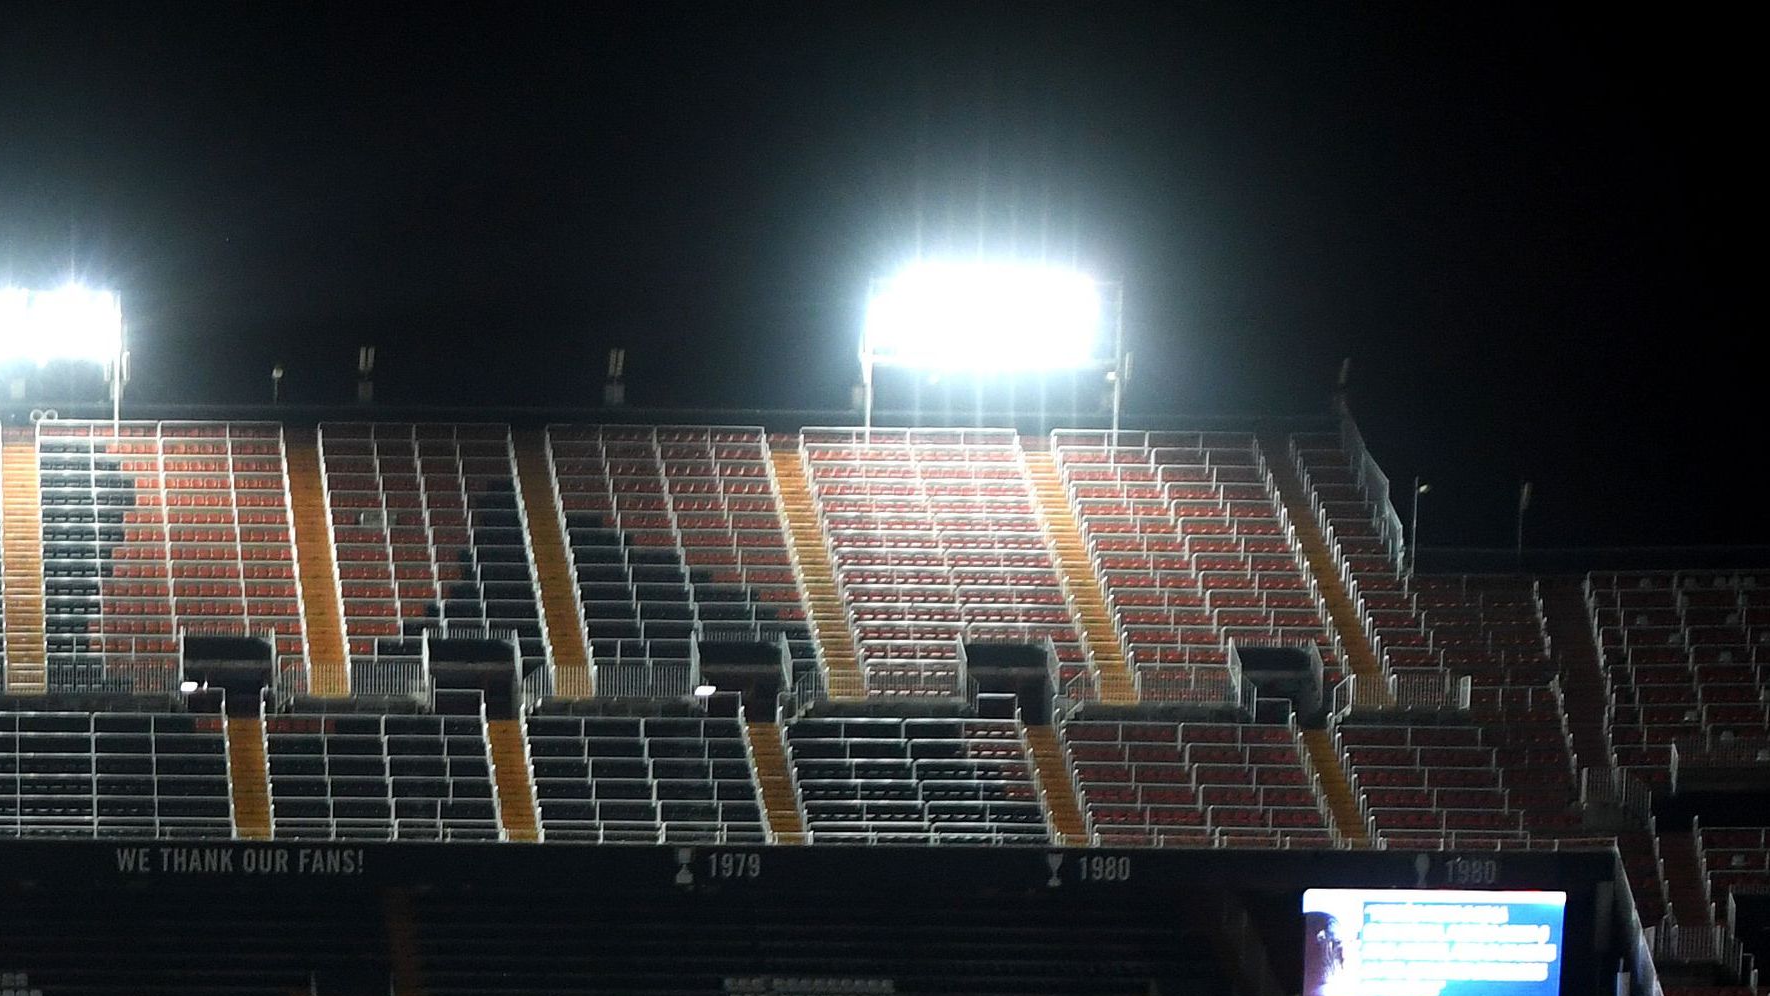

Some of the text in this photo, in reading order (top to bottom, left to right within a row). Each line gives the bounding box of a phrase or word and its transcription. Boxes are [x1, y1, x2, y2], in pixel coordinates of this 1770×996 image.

[116, 849, 364, 873] WE THANK OUR FANS!
[708, 853, 761, 877] 1979
[1078, 856, 1130, 881] 1980
[1445, 859, 1497, 885] 1980
